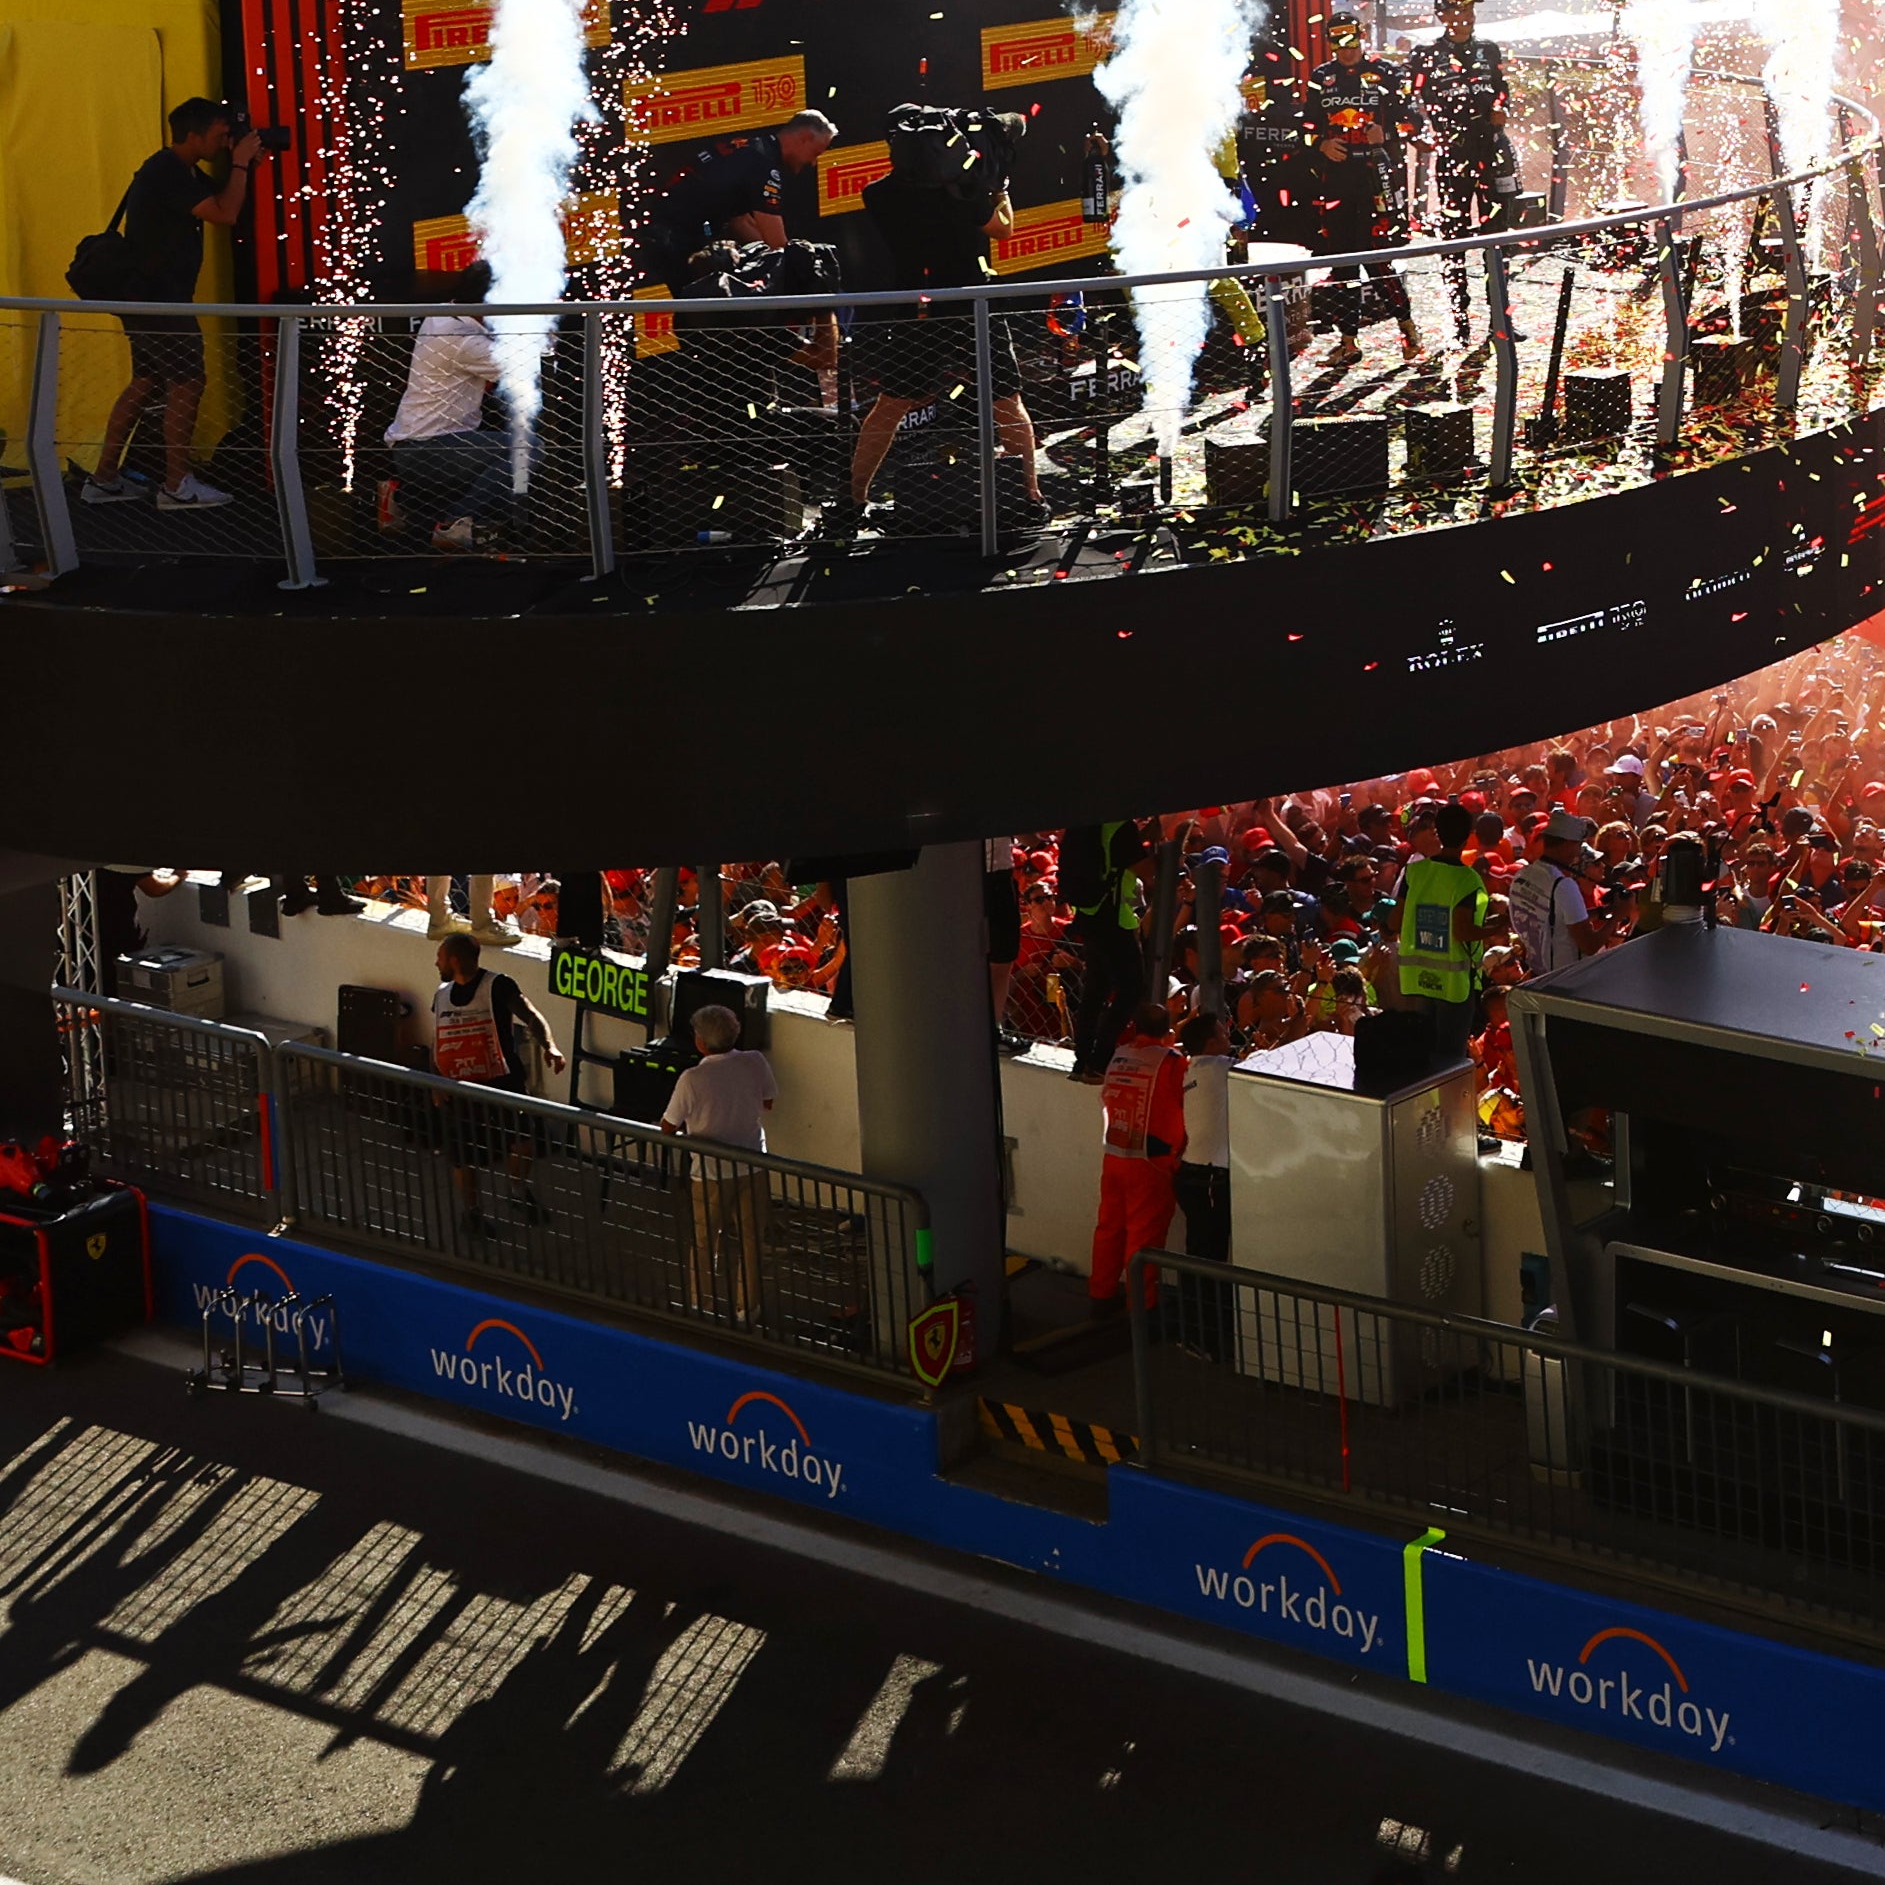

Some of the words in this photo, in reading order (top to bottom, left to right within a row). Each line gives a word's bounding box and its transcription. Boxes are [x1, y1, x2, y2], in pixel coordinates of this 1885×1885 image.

[990, 32, 1076, 75] PIRELLI
[635, 81, 742, 130] PIRELLI
[751, 74, 797, 110] 150
[1320, 95, 1380, 109] ORACLE
[1000, 214, 1085, 261] PIRELLI
[556, 951, 649, 1016] GEORGE
[193, 1283, 326, 1351] workday
[431, 1348, 575, 1420] workday
[688, 1421, 843, 1498] workday
[1196, 1564, 1380, 1653] workday
[1527, 1659, 1731, 1752] workday
